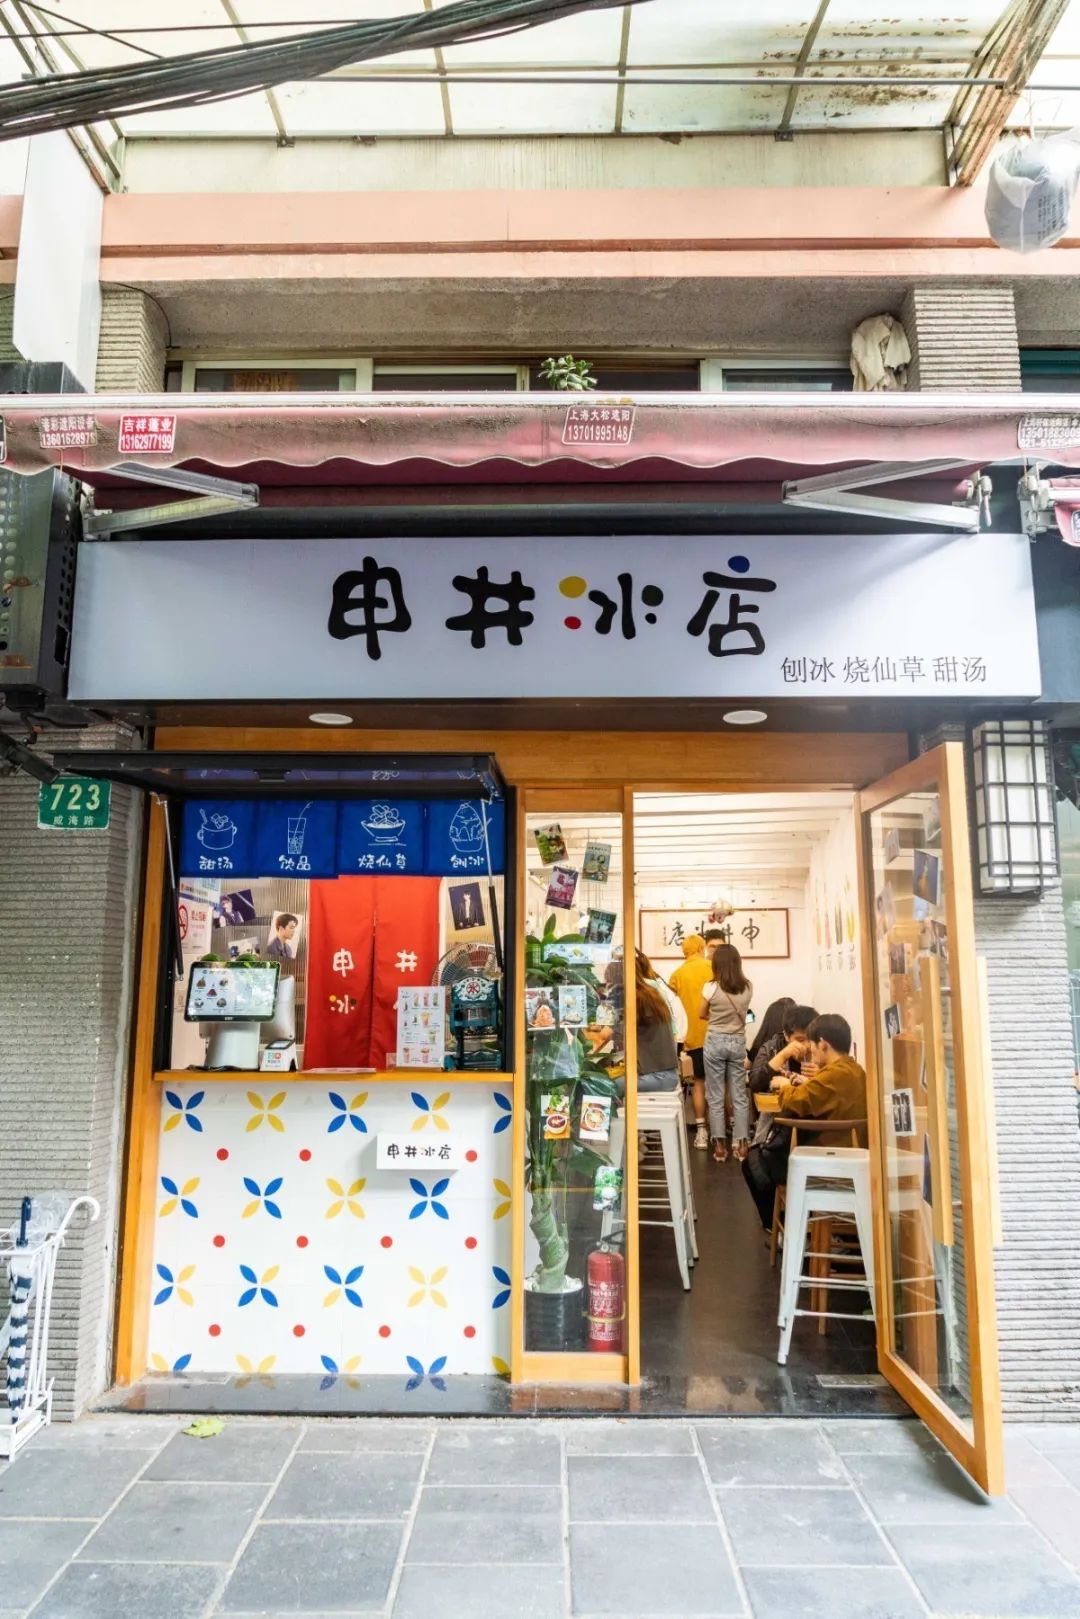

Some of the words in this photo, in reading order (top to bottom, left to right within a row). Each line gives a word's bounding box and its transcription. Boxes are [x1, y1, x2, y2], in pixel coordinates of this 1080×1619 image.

[568, 424, 628, 441] 13701995148
[328, 556, 776, 660] 申井冰店
[780, 656, 836, 683] 刨冰
[843, 656, 926, 683] 烧仙草
[932, 656, 987, 683] 甜汤
[50, 784, 100, 810] 723
[199, 855, 233, 870] 甜汤
[278, 855, 311, 870] 饮品
[387, 1143, 452, 1160] 申井冰店
